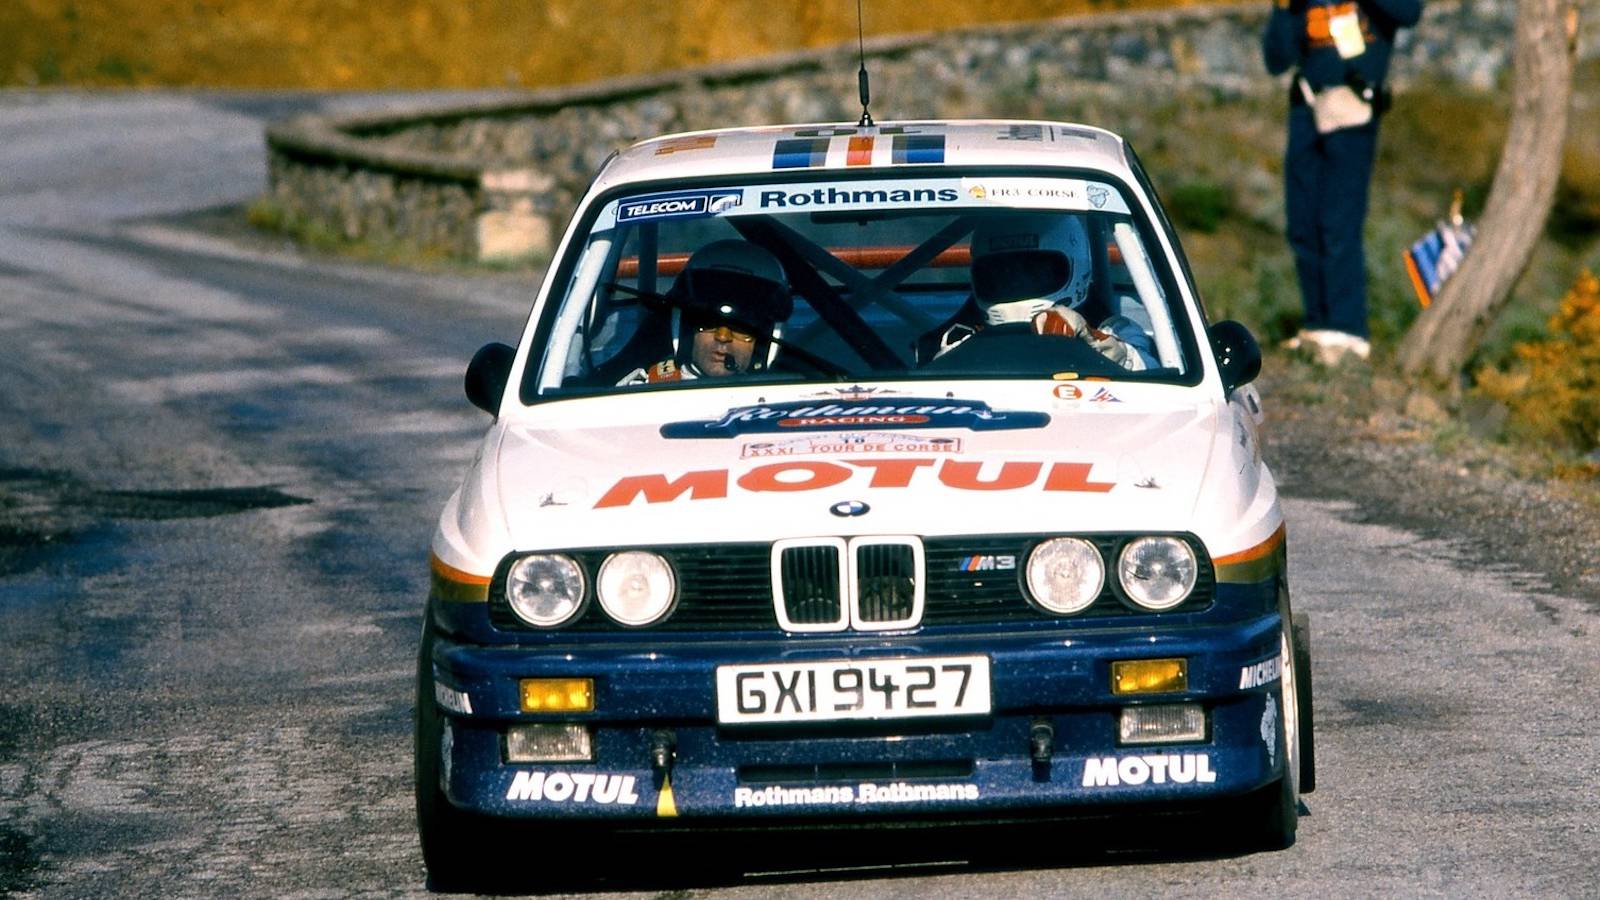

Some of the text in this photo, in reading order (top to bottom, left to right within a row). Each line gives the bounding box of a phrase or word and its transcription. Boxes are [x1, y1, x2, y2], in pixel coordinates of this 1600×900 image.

[760, 187, 959, 208] Rothmans
[1027, 188, 1080, 199] CORSE
[627, 199, 696, 217] TELECOM
[800, 416, 906, 425] RACING
[751, 443, 953, 457] XXXI TOUR DE CORSE
[591, 458, 1117, 510] MOTUL
[975, 554, 1016, 571] M3
[735, 664, 972, 715] GXI 9427
[1082, 754, 1216, 787] MOTUL
[506, 770, 639, 805] MOTUL
[734, 783, 980, 807] Rothmans Rothmans
